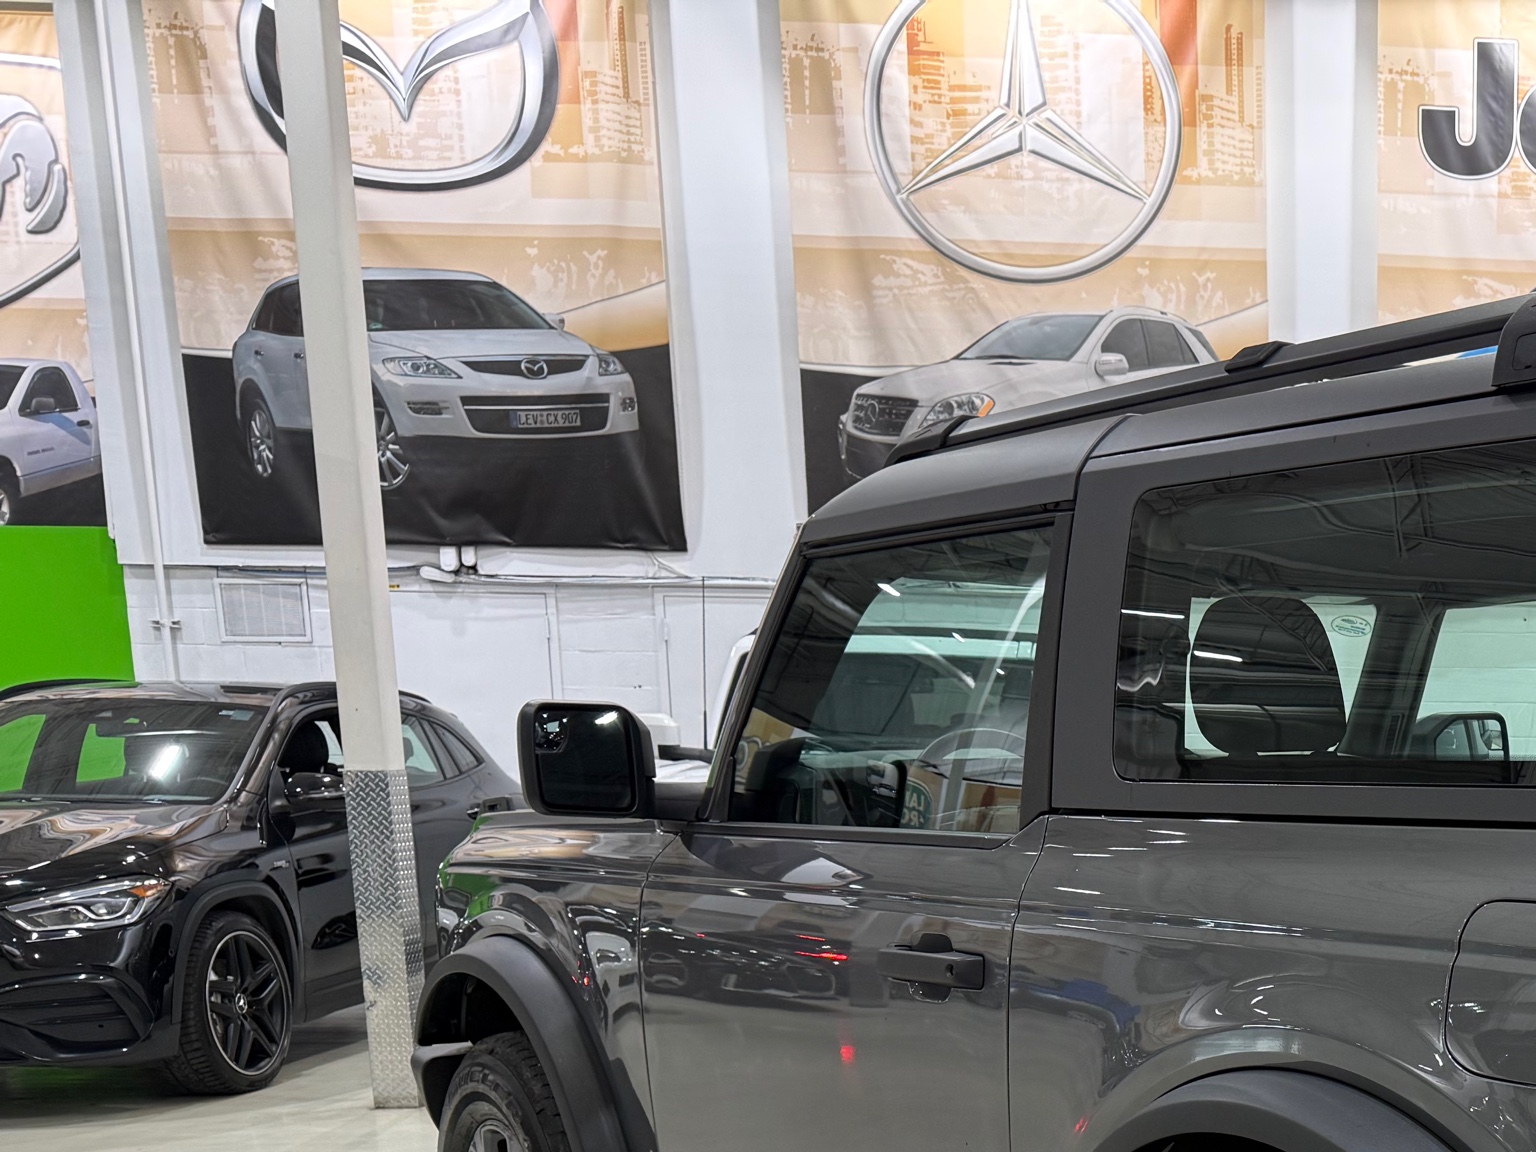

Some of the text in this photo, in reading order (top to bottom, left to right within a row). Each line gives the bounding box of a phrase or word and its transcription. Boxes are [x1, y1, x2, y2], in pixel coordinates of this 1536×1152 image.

[518, 411, 580, 426] LEV CX 907
